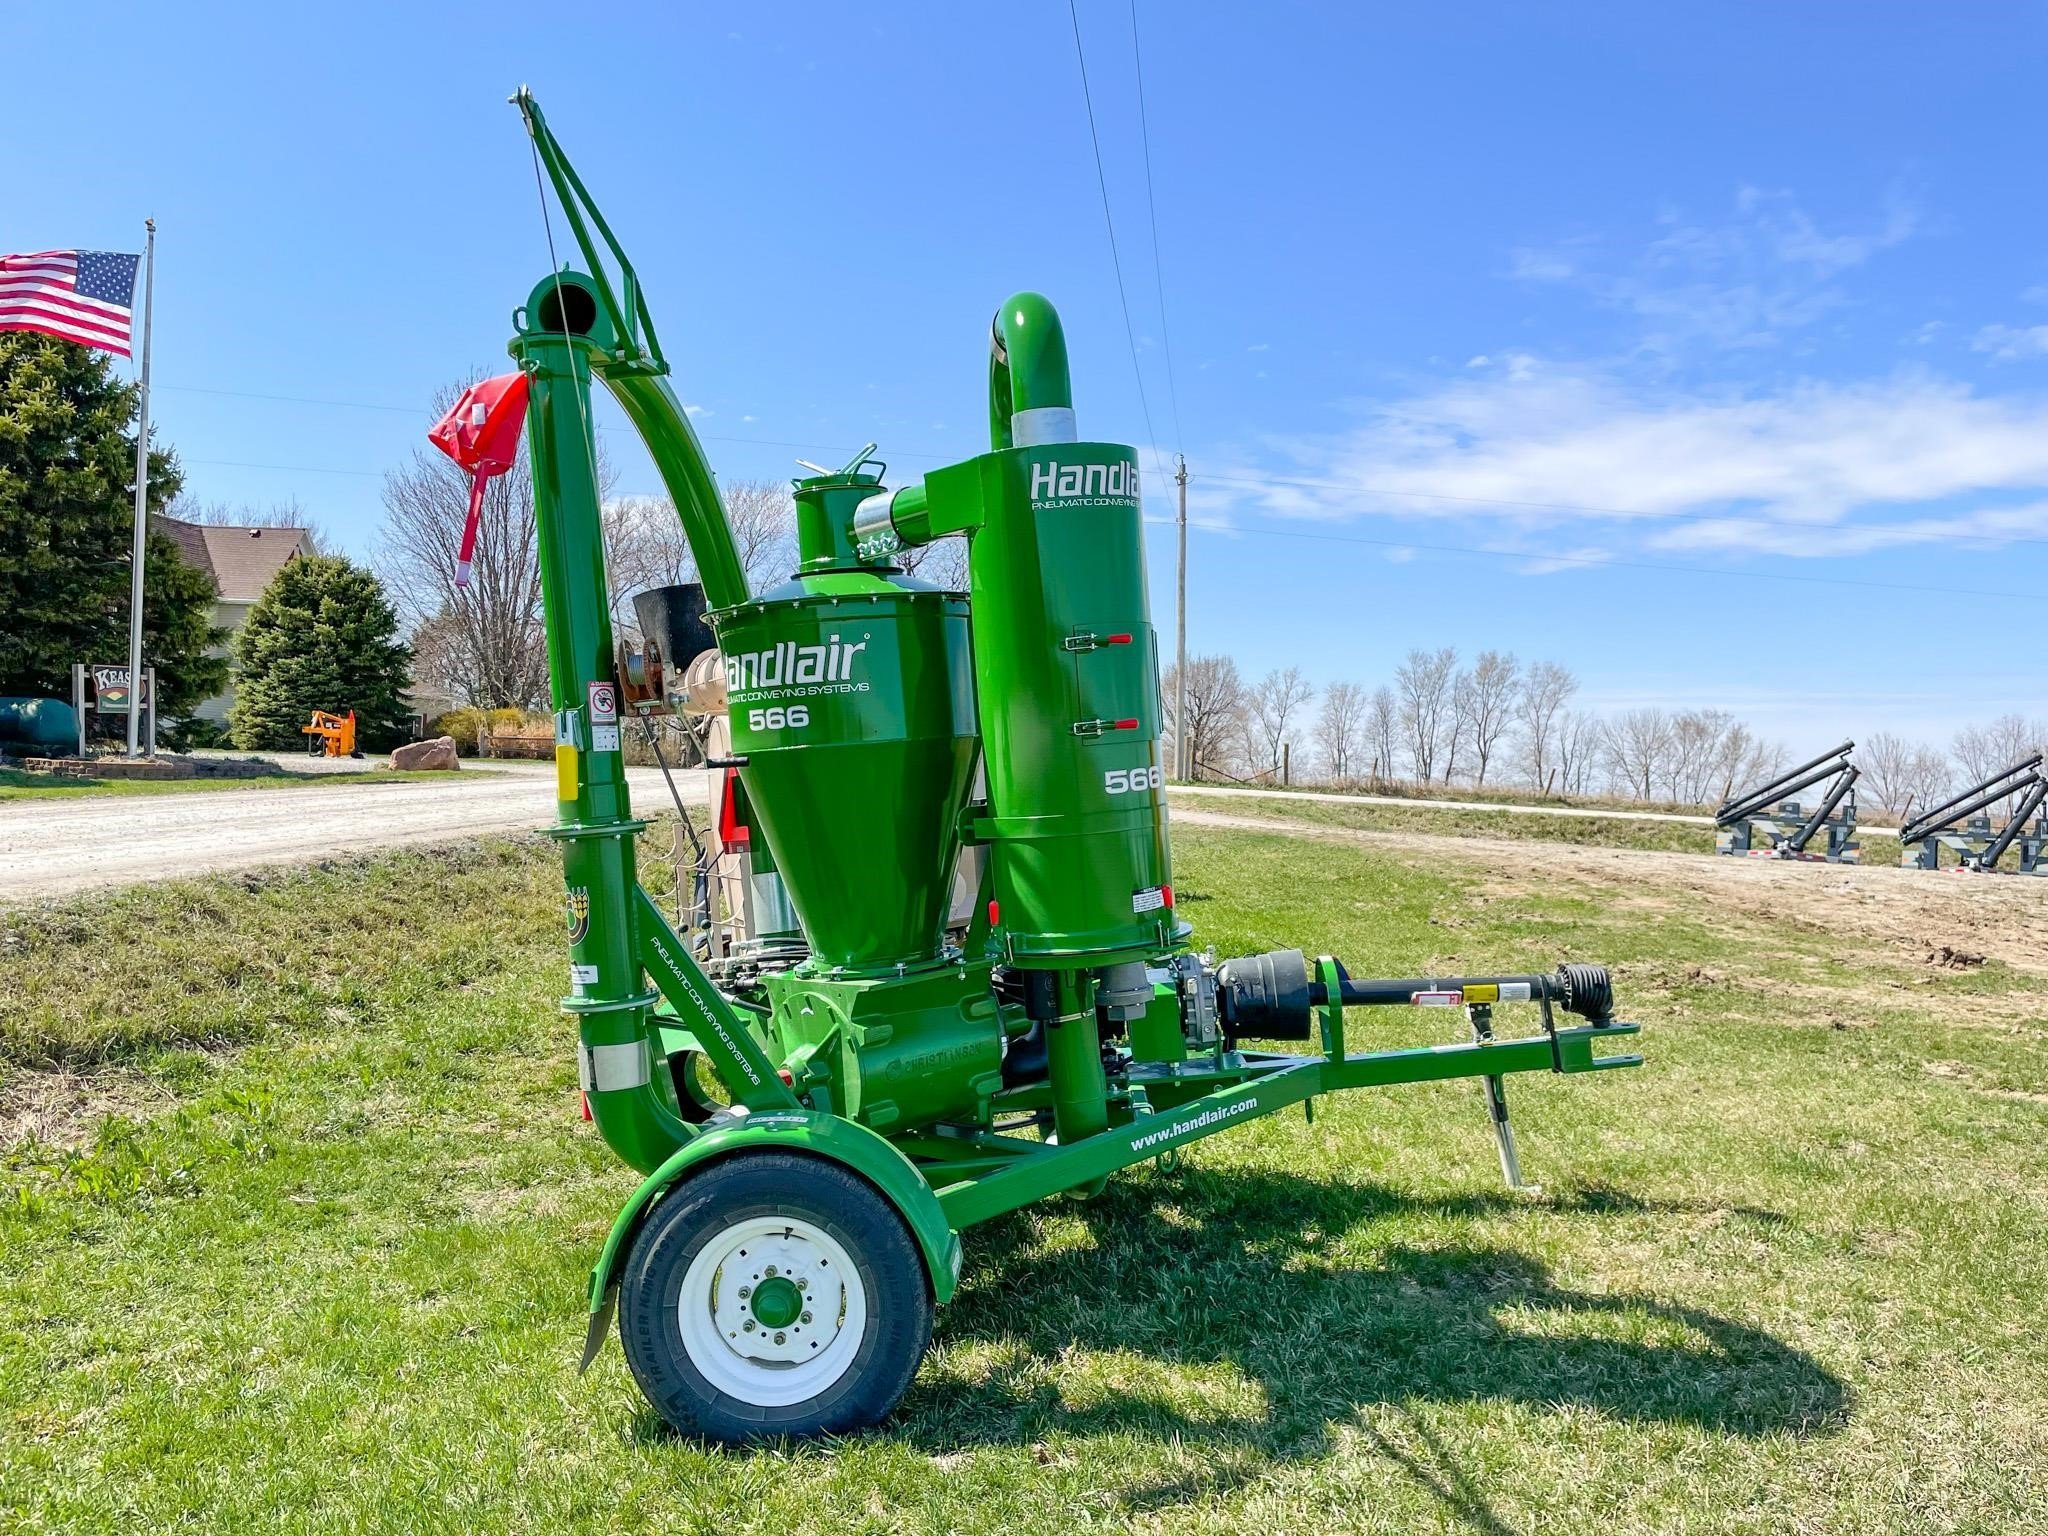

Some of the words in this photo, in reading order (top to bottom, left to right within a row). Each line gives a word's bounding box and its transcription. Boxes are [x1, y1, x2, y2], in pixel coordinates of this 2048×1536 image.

[1031, 460, 1140, 499] Handla
[1032, 498, 1092, 510] PNEUMATIC
[727, 633, 866, 692] andlair
[95, 668, 130, 690] KEAS
[747, 685, 806, 701] CONVEYING
[809, 682, 870, 696] SYSTEMS
[749, 705, 810, 732] 566
[1104, 765, 1161, 795] 566
[650, 936, 692, 990] PNEUMATIC
[688, 987, 728, 1042] CONVEYING
[726, 1040, 761, 1086] SYSTEMS
[1130, 1097, 1258, 1152] www.handlair.com
